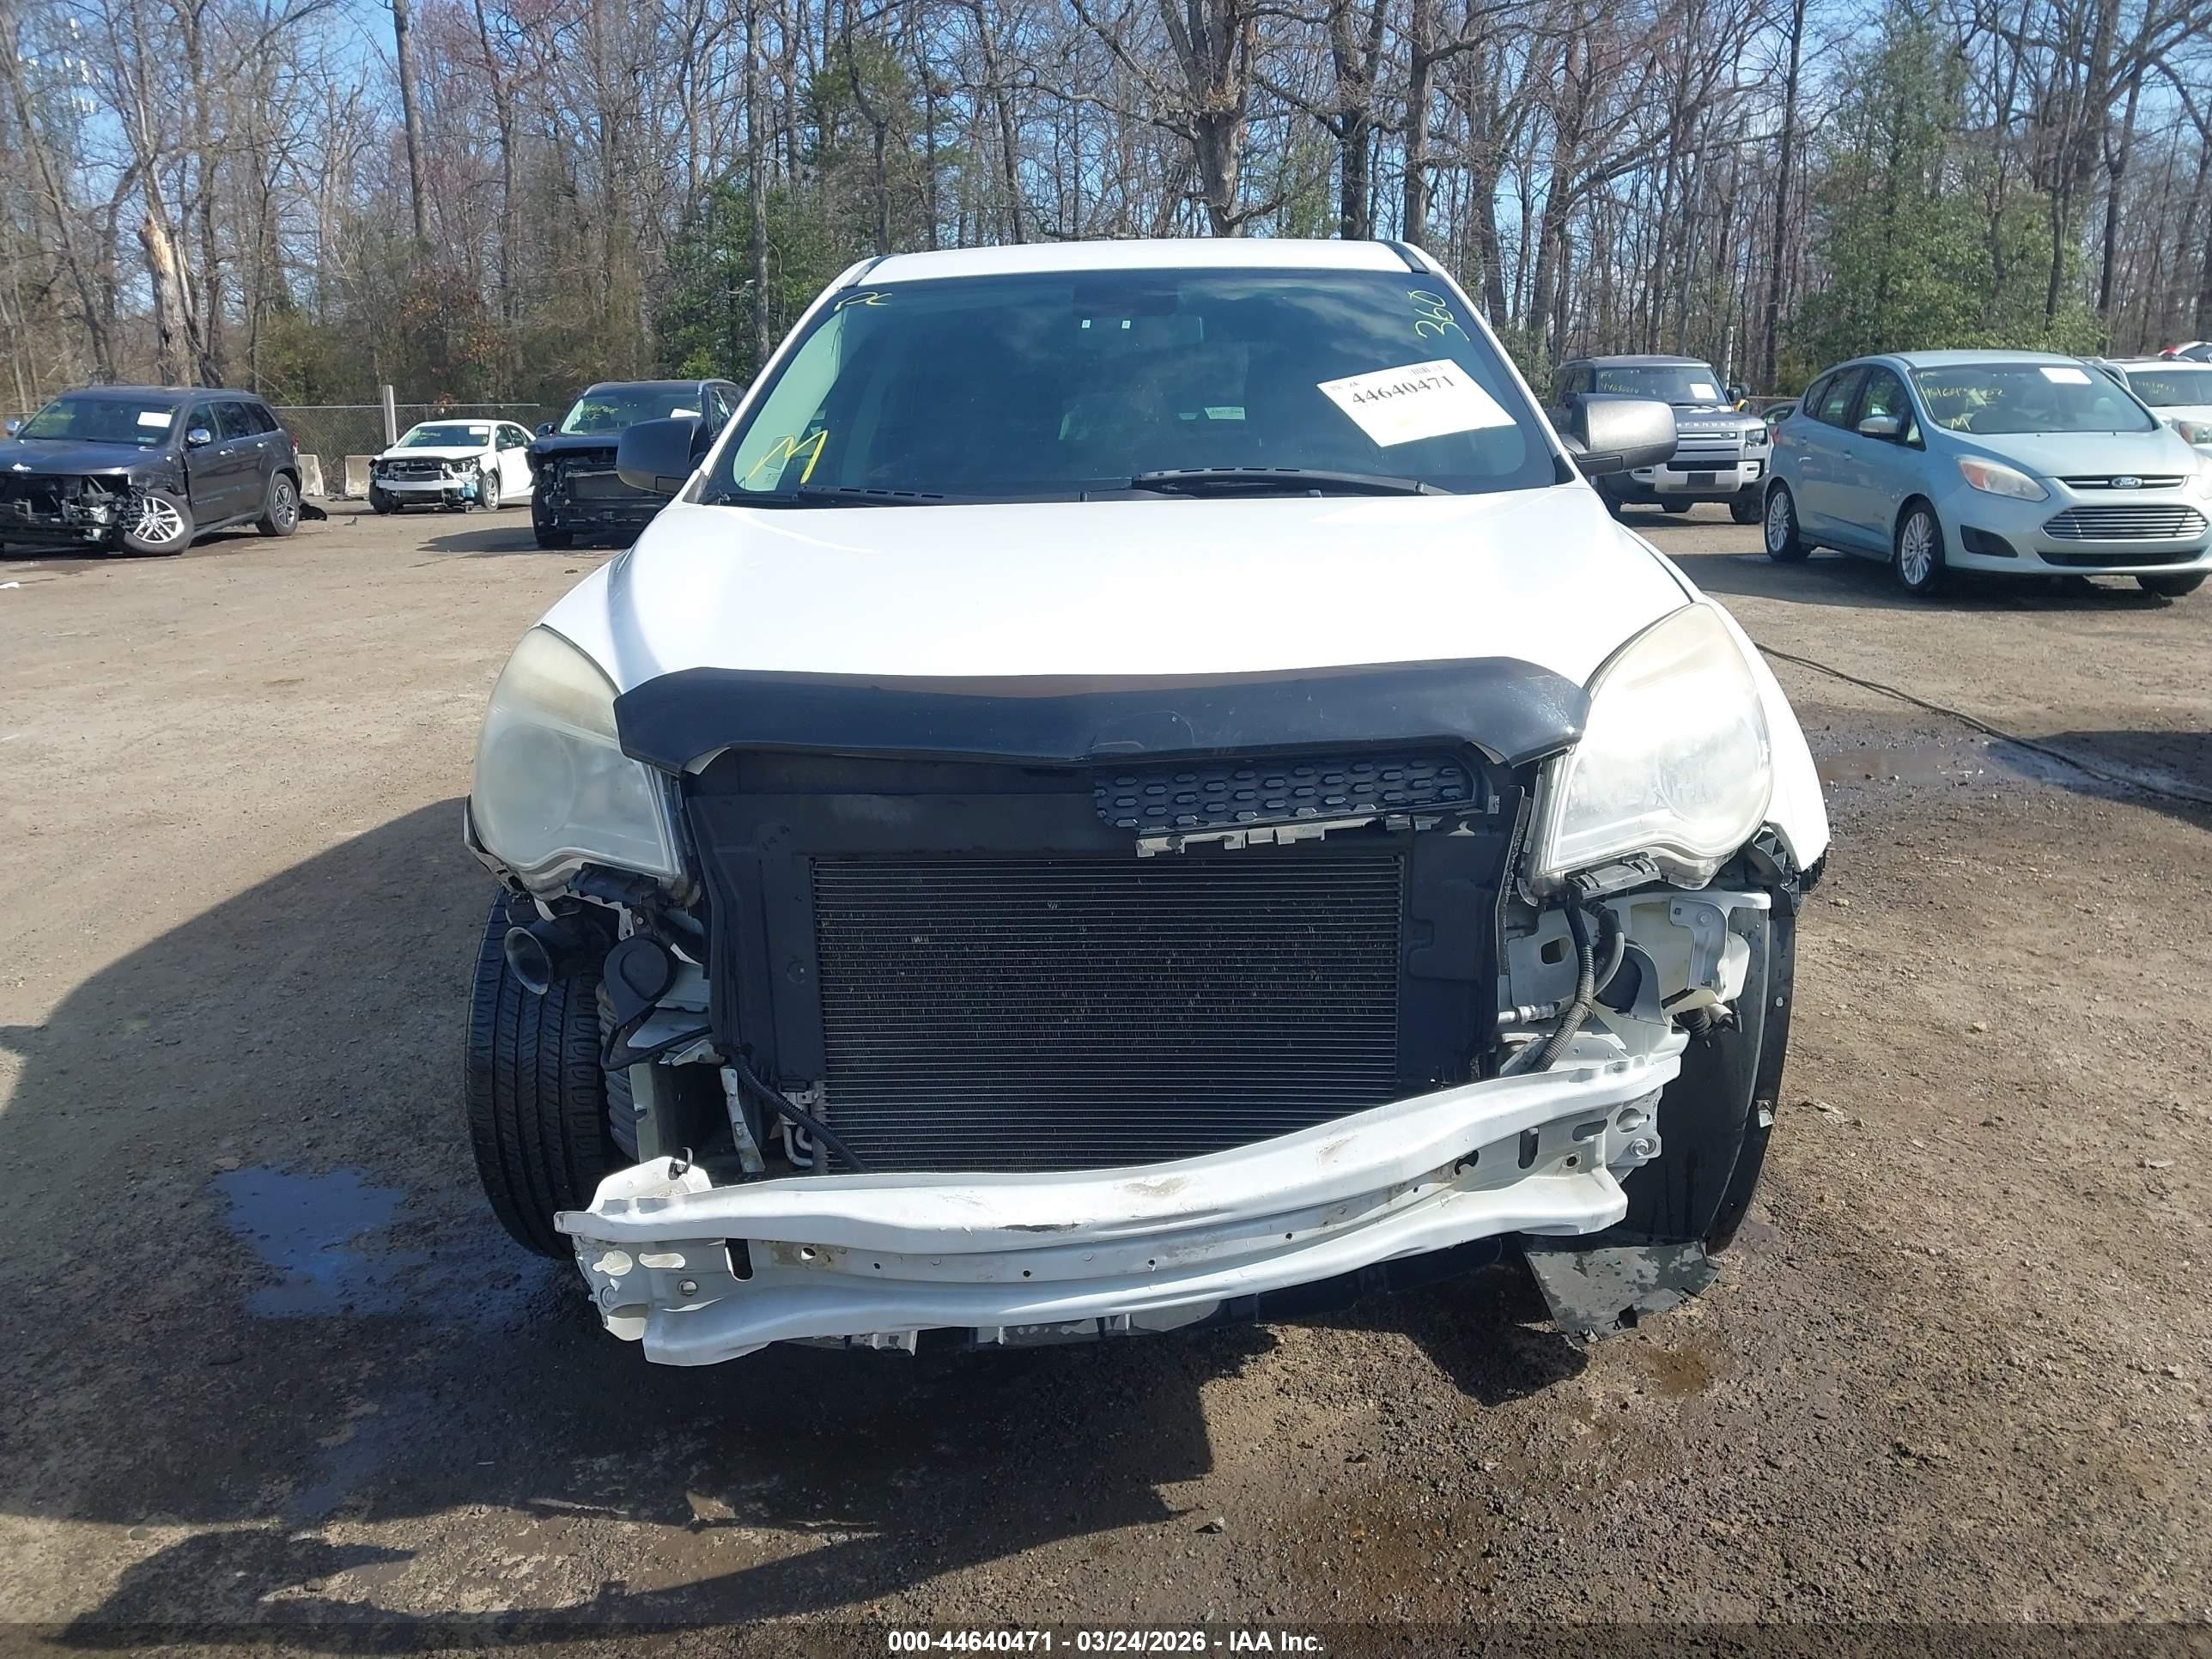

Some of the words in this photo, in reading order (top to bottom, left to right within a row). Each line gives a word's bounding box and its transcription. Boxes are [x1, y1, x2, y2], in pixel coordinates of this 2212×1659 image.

[1407, 290, 1470, 342] 360
[1352, 375, 1455, 404] 44640471
[1950, 417, 1972, 432] M
[745, 429, 829, 484] M
